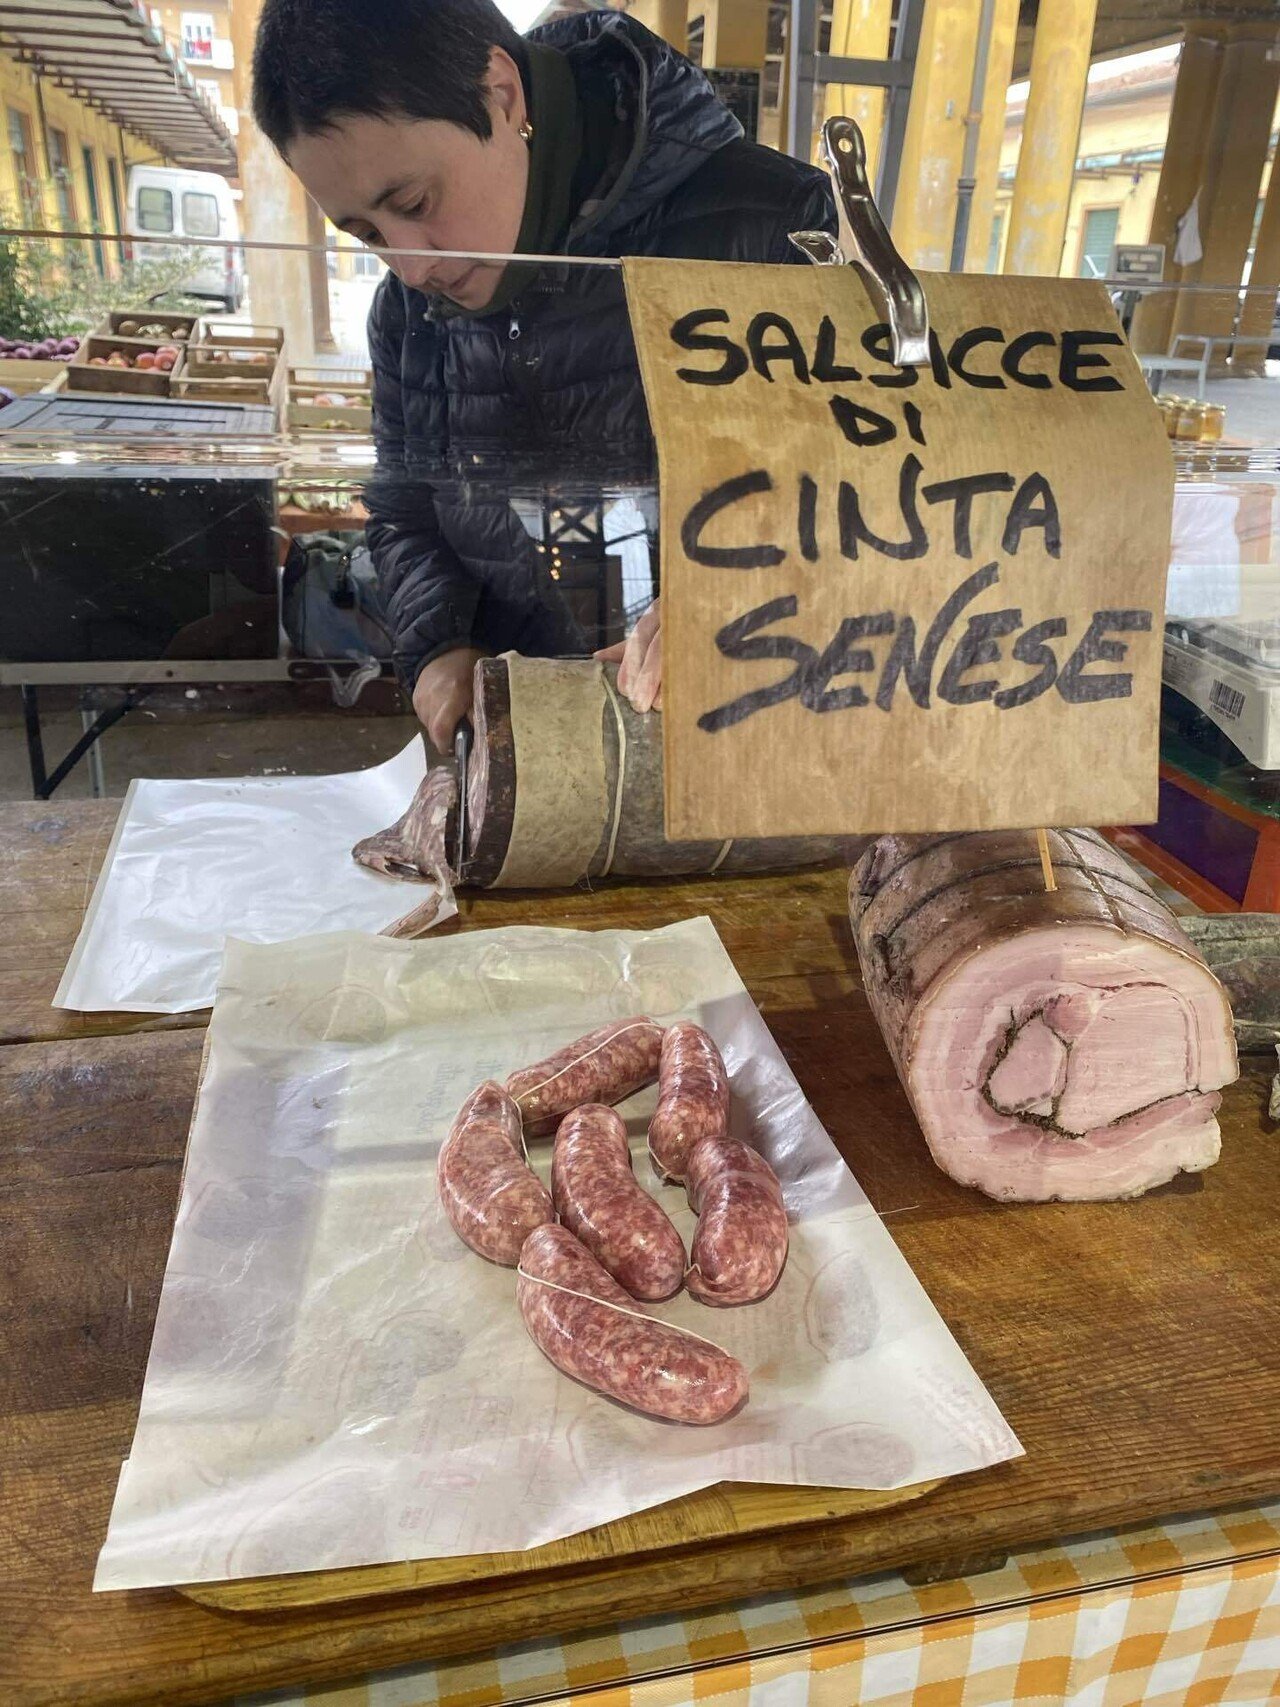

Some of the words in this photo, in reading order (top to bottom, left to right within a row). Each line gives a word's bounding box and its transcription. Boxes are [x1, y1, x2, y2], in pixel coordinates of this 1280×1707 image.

[671, 309, 1125, 391] SALSICCE
[829, 395, 927, 447] DI
[681, 453, 1061, 569] CINTA
[697, 562, 1152, 733] SENESE
